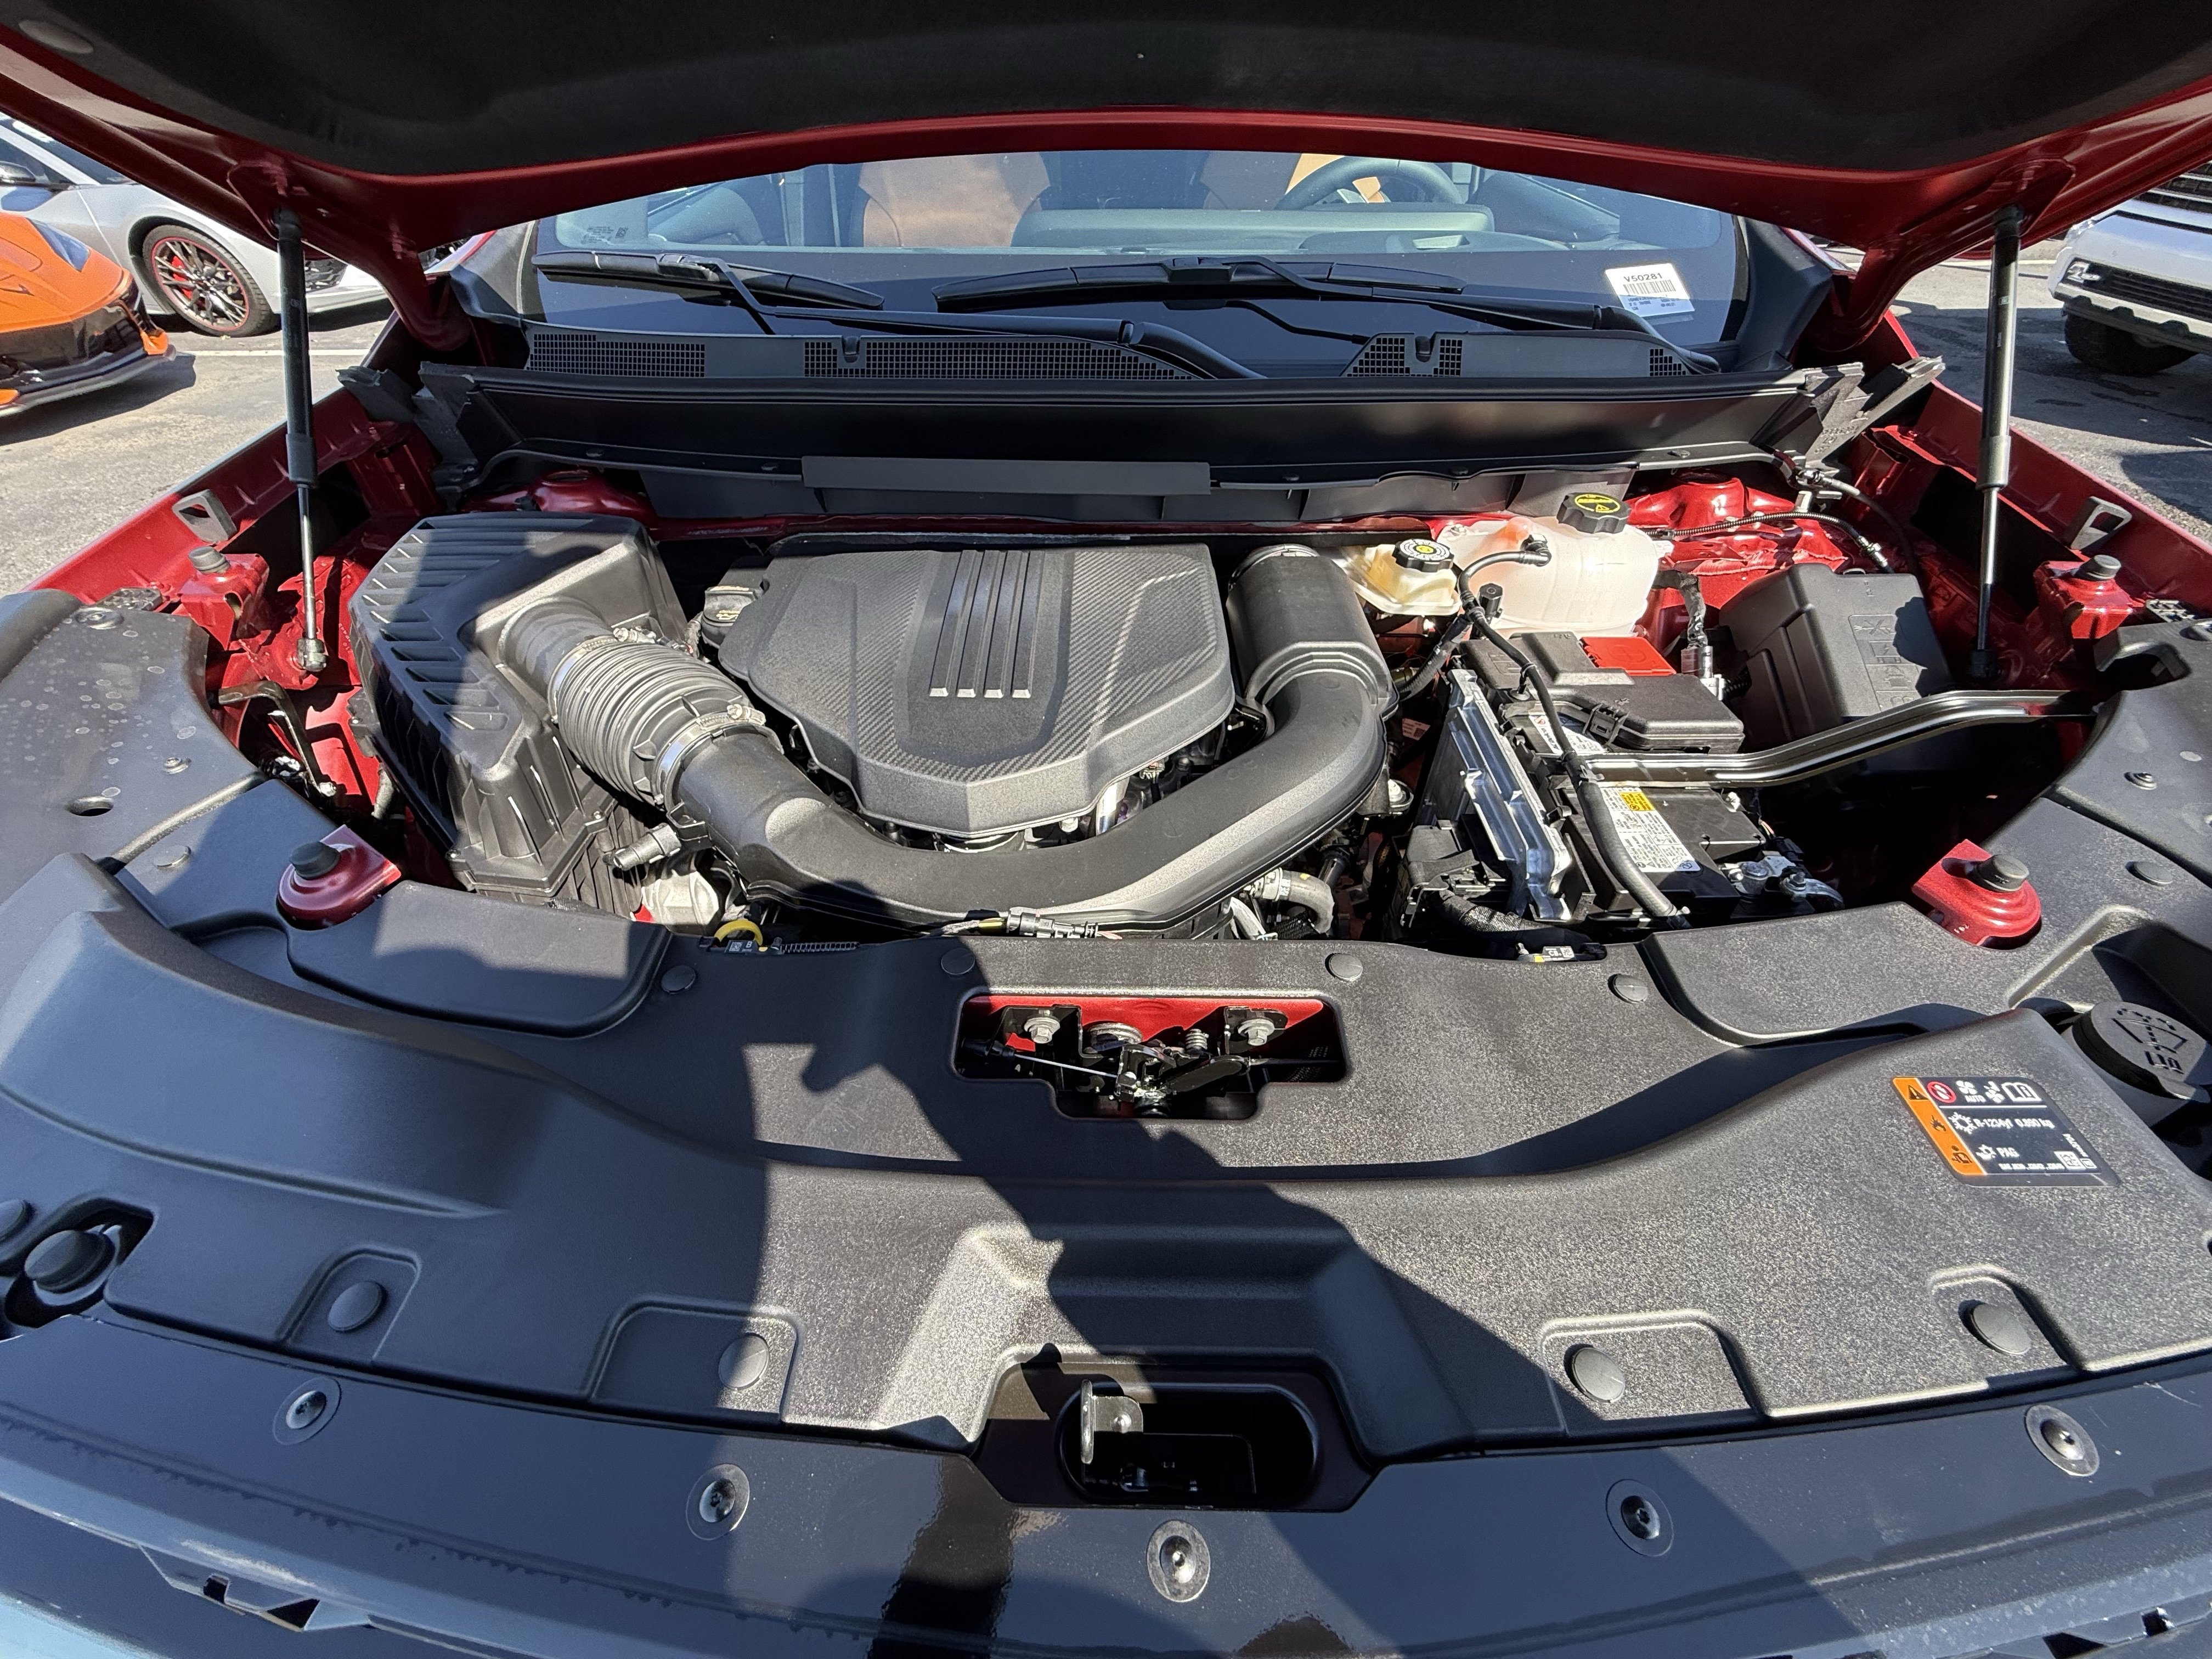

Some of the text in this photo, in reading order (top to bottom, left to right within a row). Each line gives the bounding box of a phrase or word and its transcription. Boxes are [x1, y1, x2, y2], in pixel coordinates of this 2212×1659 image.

[1623, 273, 1663, 282] V50281
[1973, 1118, 2014, 1129] R-1234yf
[2038, 1118, 2055, 1129] kg
[1996, 1147, 2020, 1158] PAG
